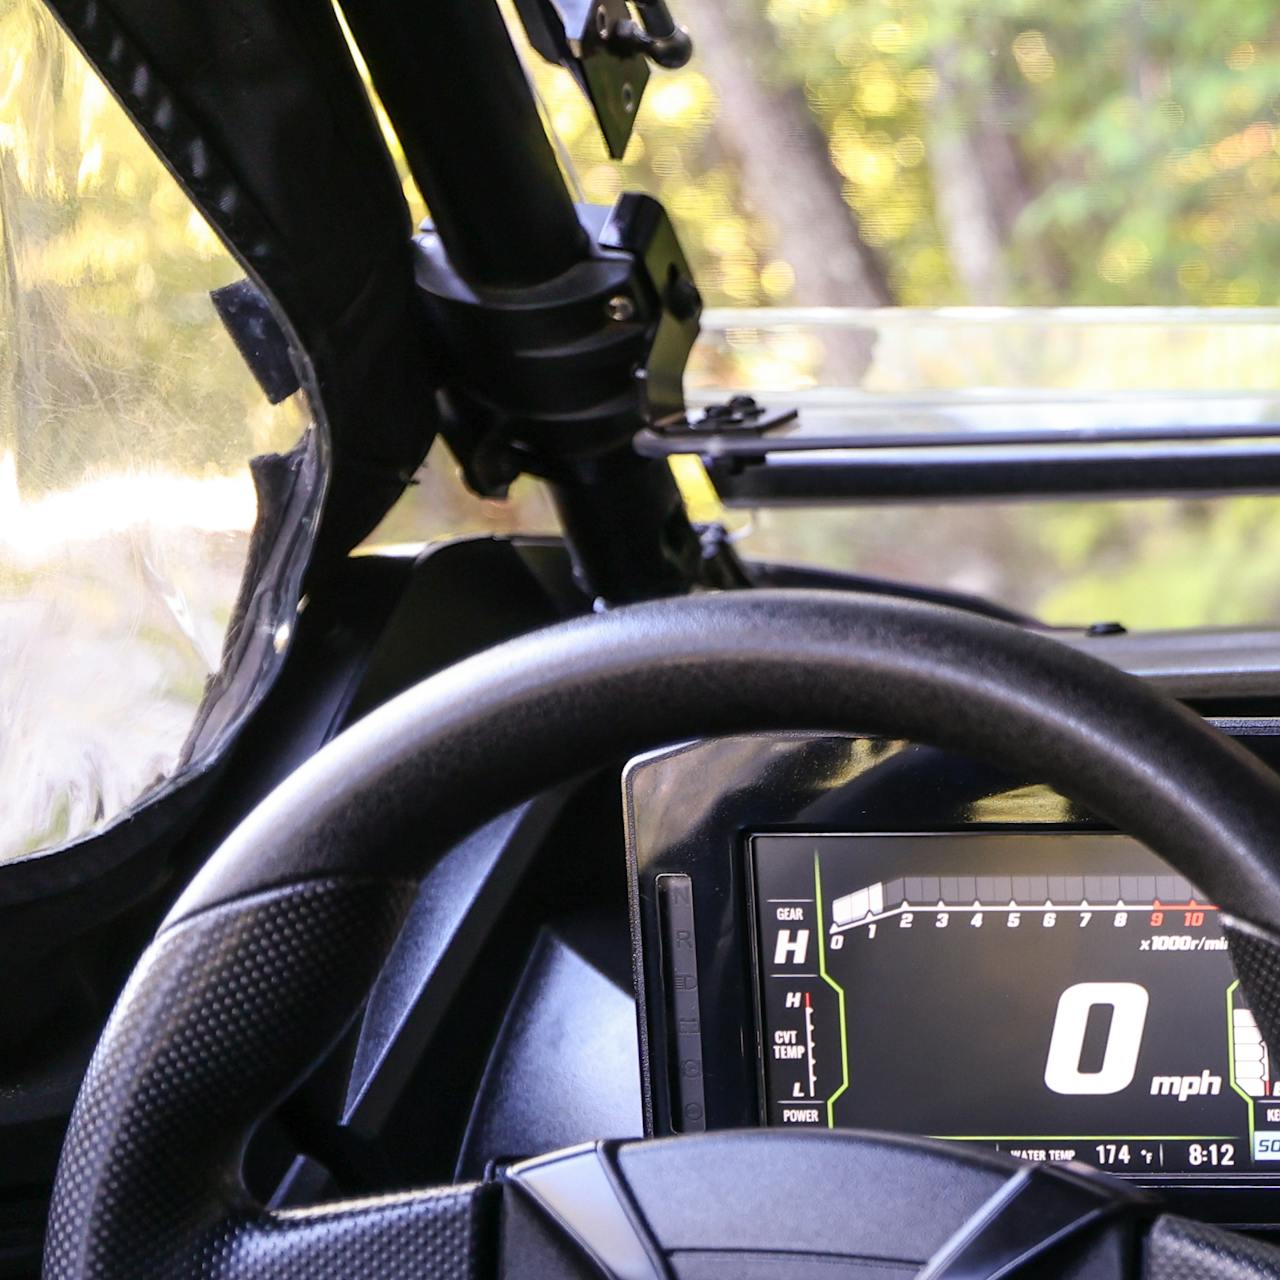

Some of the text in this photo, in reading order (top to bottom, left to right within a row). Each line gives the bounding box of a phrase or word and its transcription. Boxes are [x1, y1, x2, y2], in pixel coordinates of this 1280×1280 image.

[776, 908, 803, 921] GEAR
[899, 913, 913, 928] 2
[935, 913, 948, 928] 3
[971, 913, 983, 928] 4
[1007, 913, 1020, 928] 5
[1043, 913, 1056, 928] 6
[1079, 913, 1091, 928] 7
[1114, 913, 1127, 928] 8
[1150, 913, 1163, 928] 9
[1183, 913, 1204, 928] 10
[868, 924, 877, 939] 1
[773, 929, 810, 964] H
[830, 934, 844, 950] 0
[785, 992, 801, 1008] H
[774, 1030, 797, 1044] CVT
[1043, 982, 1149, 1095] 0
[773, 1045, 805, 1060] TEMP
[792, 1082, 804, 1097] L
[1150, 1070, 1221, 1102] mph
[783, 1109, 819, 1123] POWER
[1010, 1149, 1075, 1161] WATER TEMP
[1095, 1144, 1131, 1164] 174
[1188, 1144, 1235, 1166] 8:12
